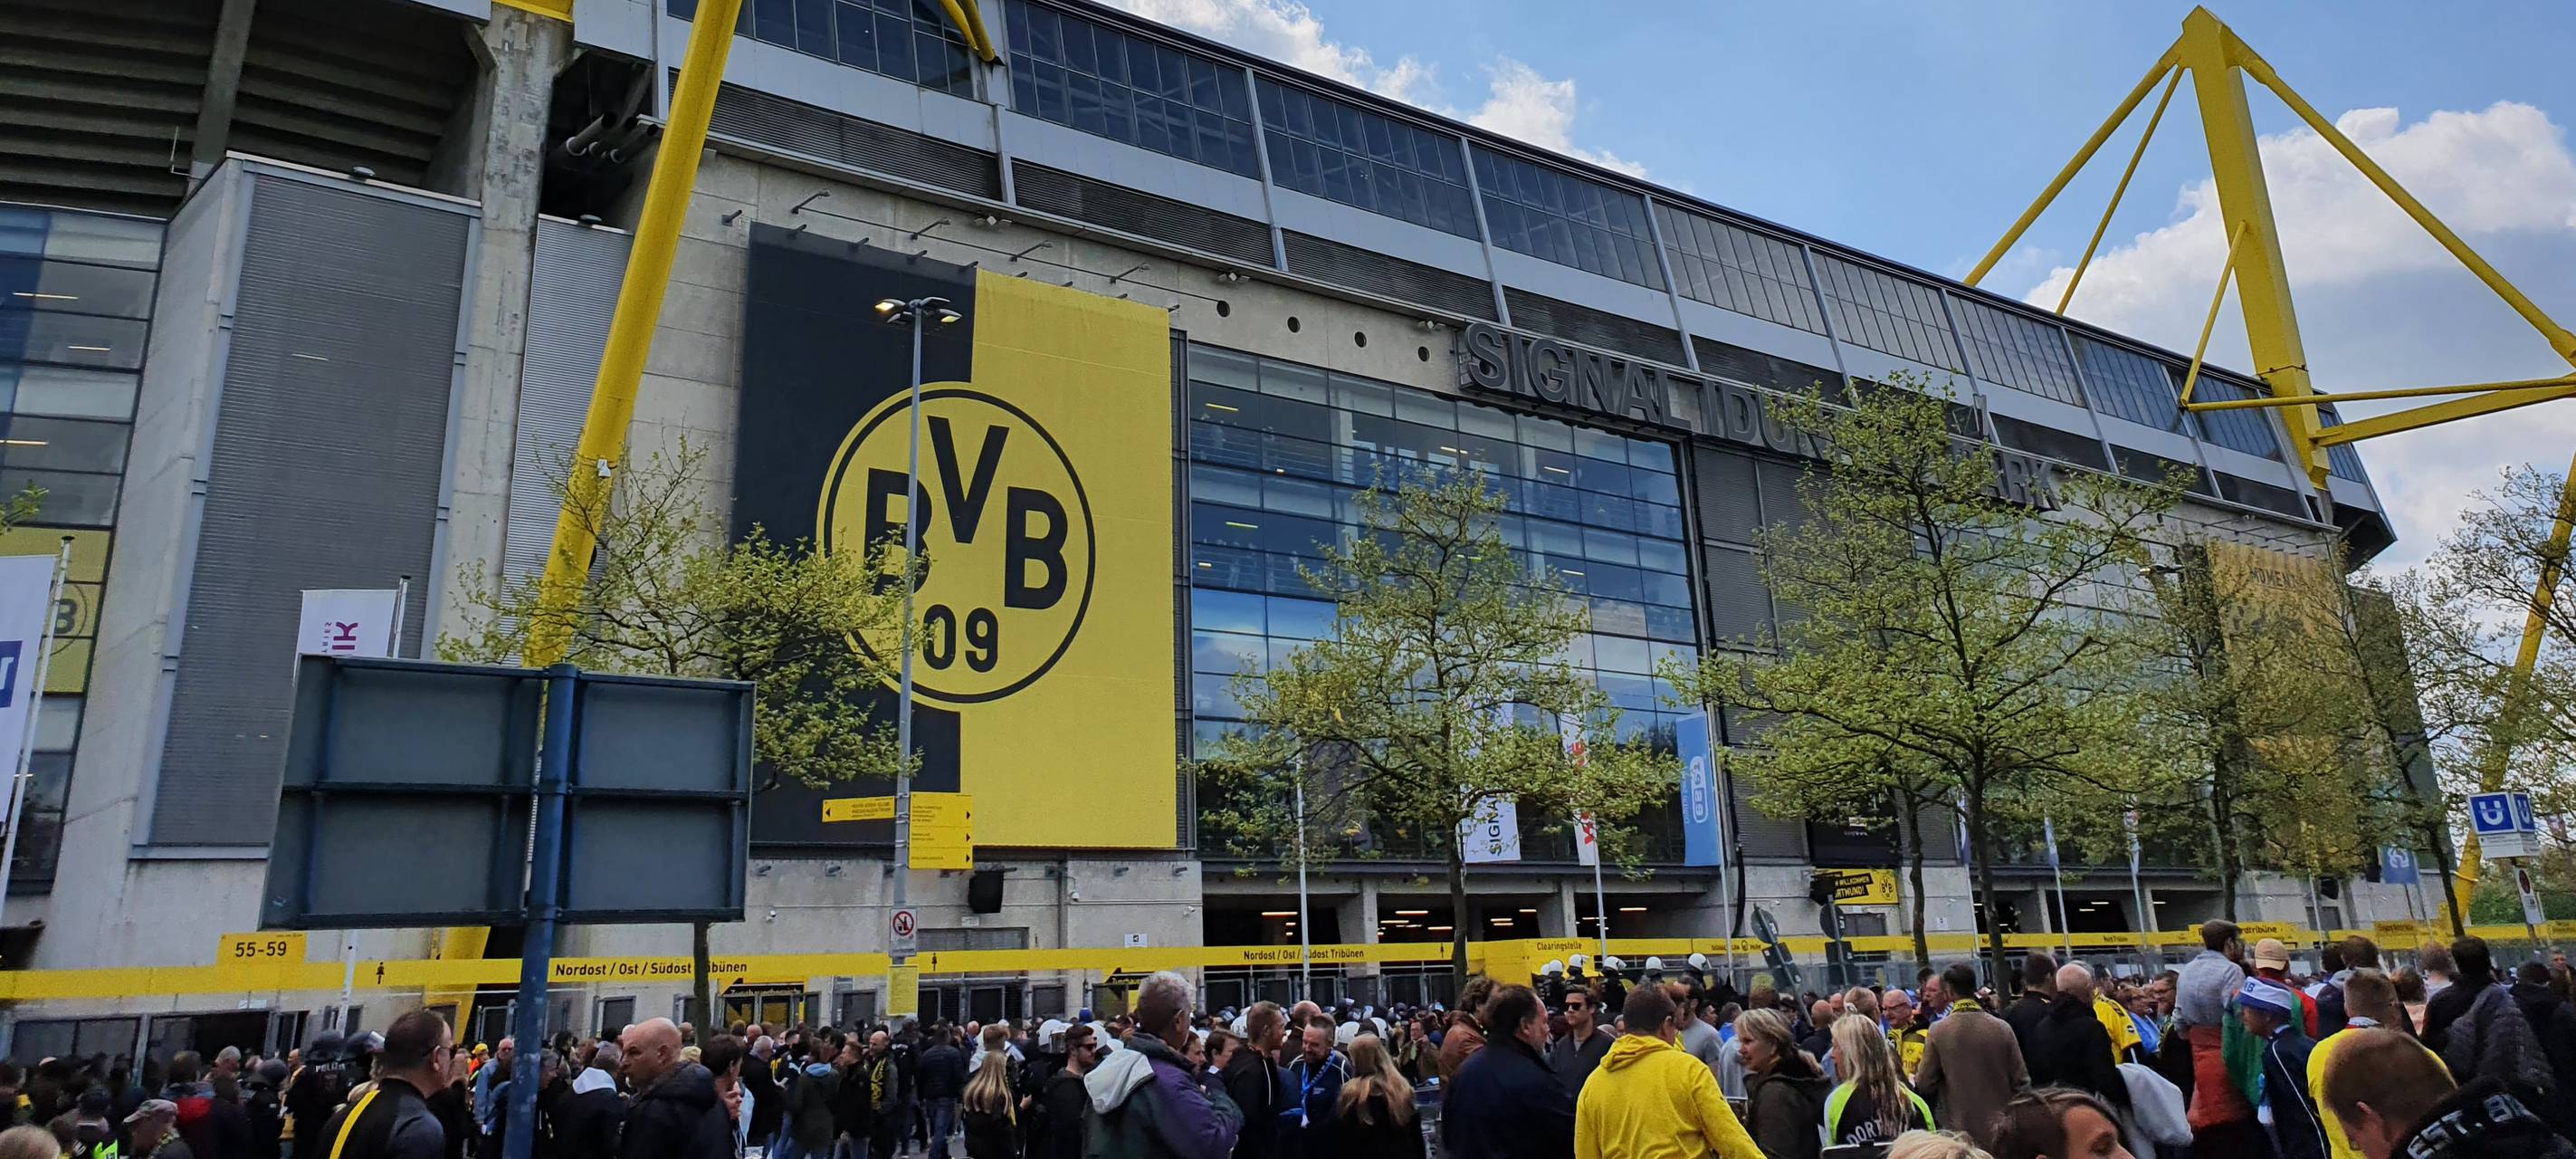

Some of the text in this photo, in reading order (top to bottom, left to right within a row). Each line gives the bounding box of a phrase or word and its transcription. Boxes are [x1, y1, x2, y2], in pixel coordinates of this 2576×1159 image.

[1465, 322, 1692, 430] SIGNAL
[863, 415, 1068, 610] BVB
[922, 603, 999, 674] 09
[235, 941, 287, 957] 55-59
[1244, 949, 1275, 960] Nordost
[1283, 949, 1296, 960] Ost
[1304, 948, 1328, 959] üdost
[1331, 947, 1364, 958] Tribünen
[1536, 942, 1582, 952] Clearingstelle
[556, 963, 606, 976] Nordost
[619, 963, 638, 975] Ost
[651, 962, 691, 974] Südost
[707, 961, 747, 972] ibünen
